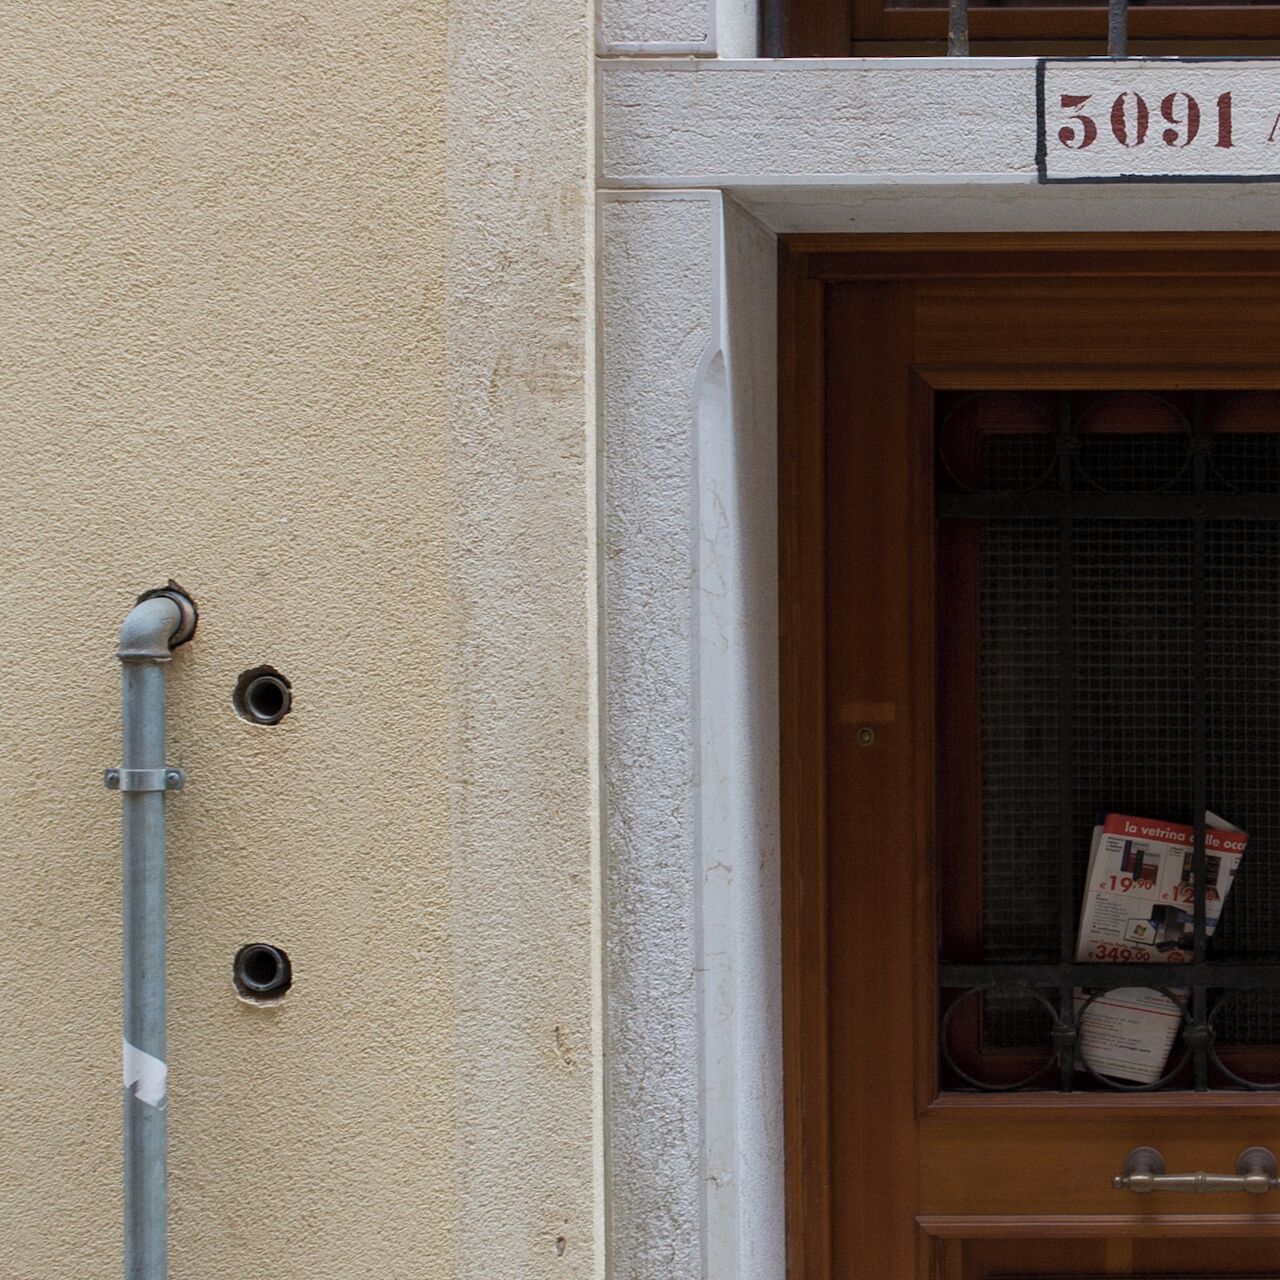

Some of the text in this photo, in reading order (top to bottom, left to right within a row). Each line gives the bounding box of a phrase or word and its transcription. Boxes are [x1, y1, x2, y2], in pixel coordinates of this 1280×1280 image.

[1058, 90, 1235, 149] 3091
[1125, 820, 1138, 833] la
[1141, 826, 1186, 842] vetrina
